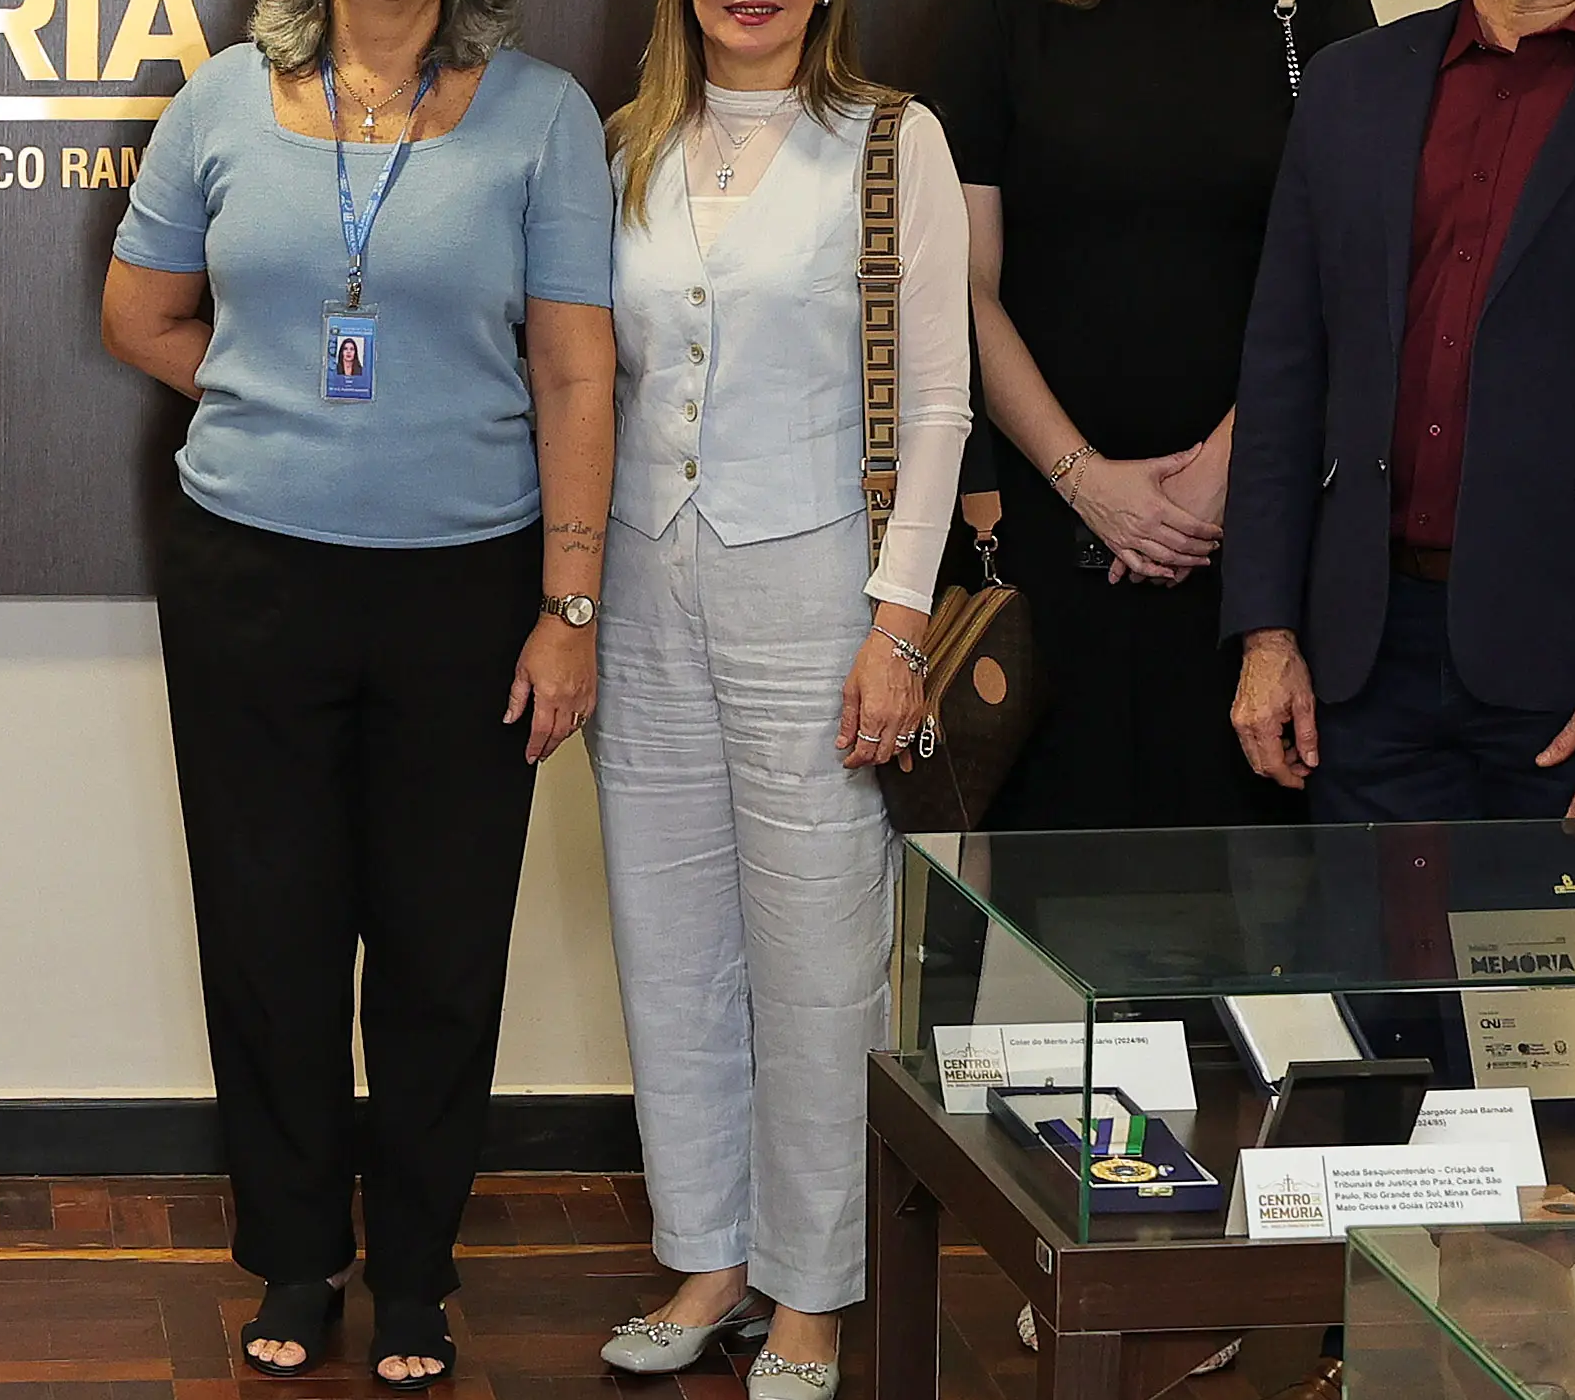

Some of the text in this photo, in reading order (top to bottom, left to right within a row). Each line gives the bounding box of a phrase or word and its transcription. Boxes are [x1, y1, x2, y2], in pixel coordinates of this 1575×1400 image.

[61, 146, 146, 189] RAM
[1470, 952, 1575, 974] MEMÓRIA
[1480, 1018, 1501, 1029] CNJ
[1068, 1037, 1112, 1046] Judiário
[944, 1059, 990, 1069] CENTRO
[1362, 1167, 1435, 1176] Sesquicentenário
[1444, 1165, 1477, 1174] Criação
[1334, 1180, 1372, 1188] Tribunais
[1387, 1179, 1418, 1187] Justiça
[1456, 1176, 1483, 1184] Ceará,
[1258, 1194, 1311, 1206] CENTRO
[1334, 1192, 1361, 1200] Paulo,
[1379, 1190, 1410, 1198] Grande
